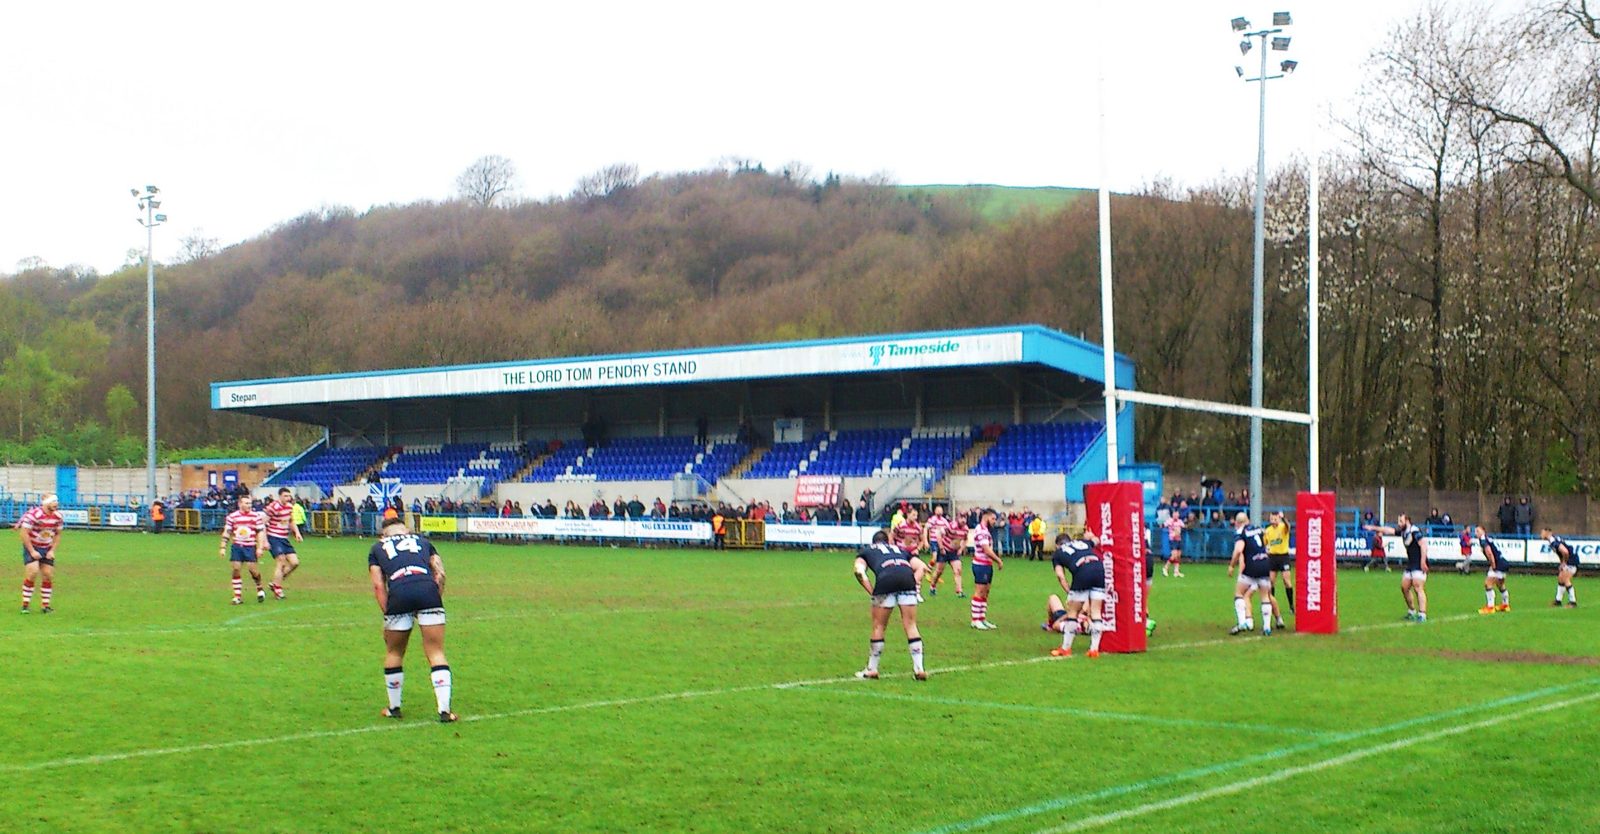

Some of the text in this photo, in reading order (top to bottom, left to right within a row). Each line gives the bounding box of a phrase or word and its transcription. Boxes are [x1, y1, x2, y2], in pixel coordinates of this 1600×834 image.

[888, 340, 960, 356] Tameside
[503, 361, 697, 386] THE LORD TOM PENDRY STAND
[231, 393, 257, 404] Stepan
[381, 538, 422, 560] 14
[1131, 512, 1141, 558] CIDER
[1308, 516, 1321, 557] CIDER
[1100, 502, 1118, 632] Kingstone Press
[1307, 559, 1321, 611] PROPER
[1133, 561, 1142, 623] PROPER
